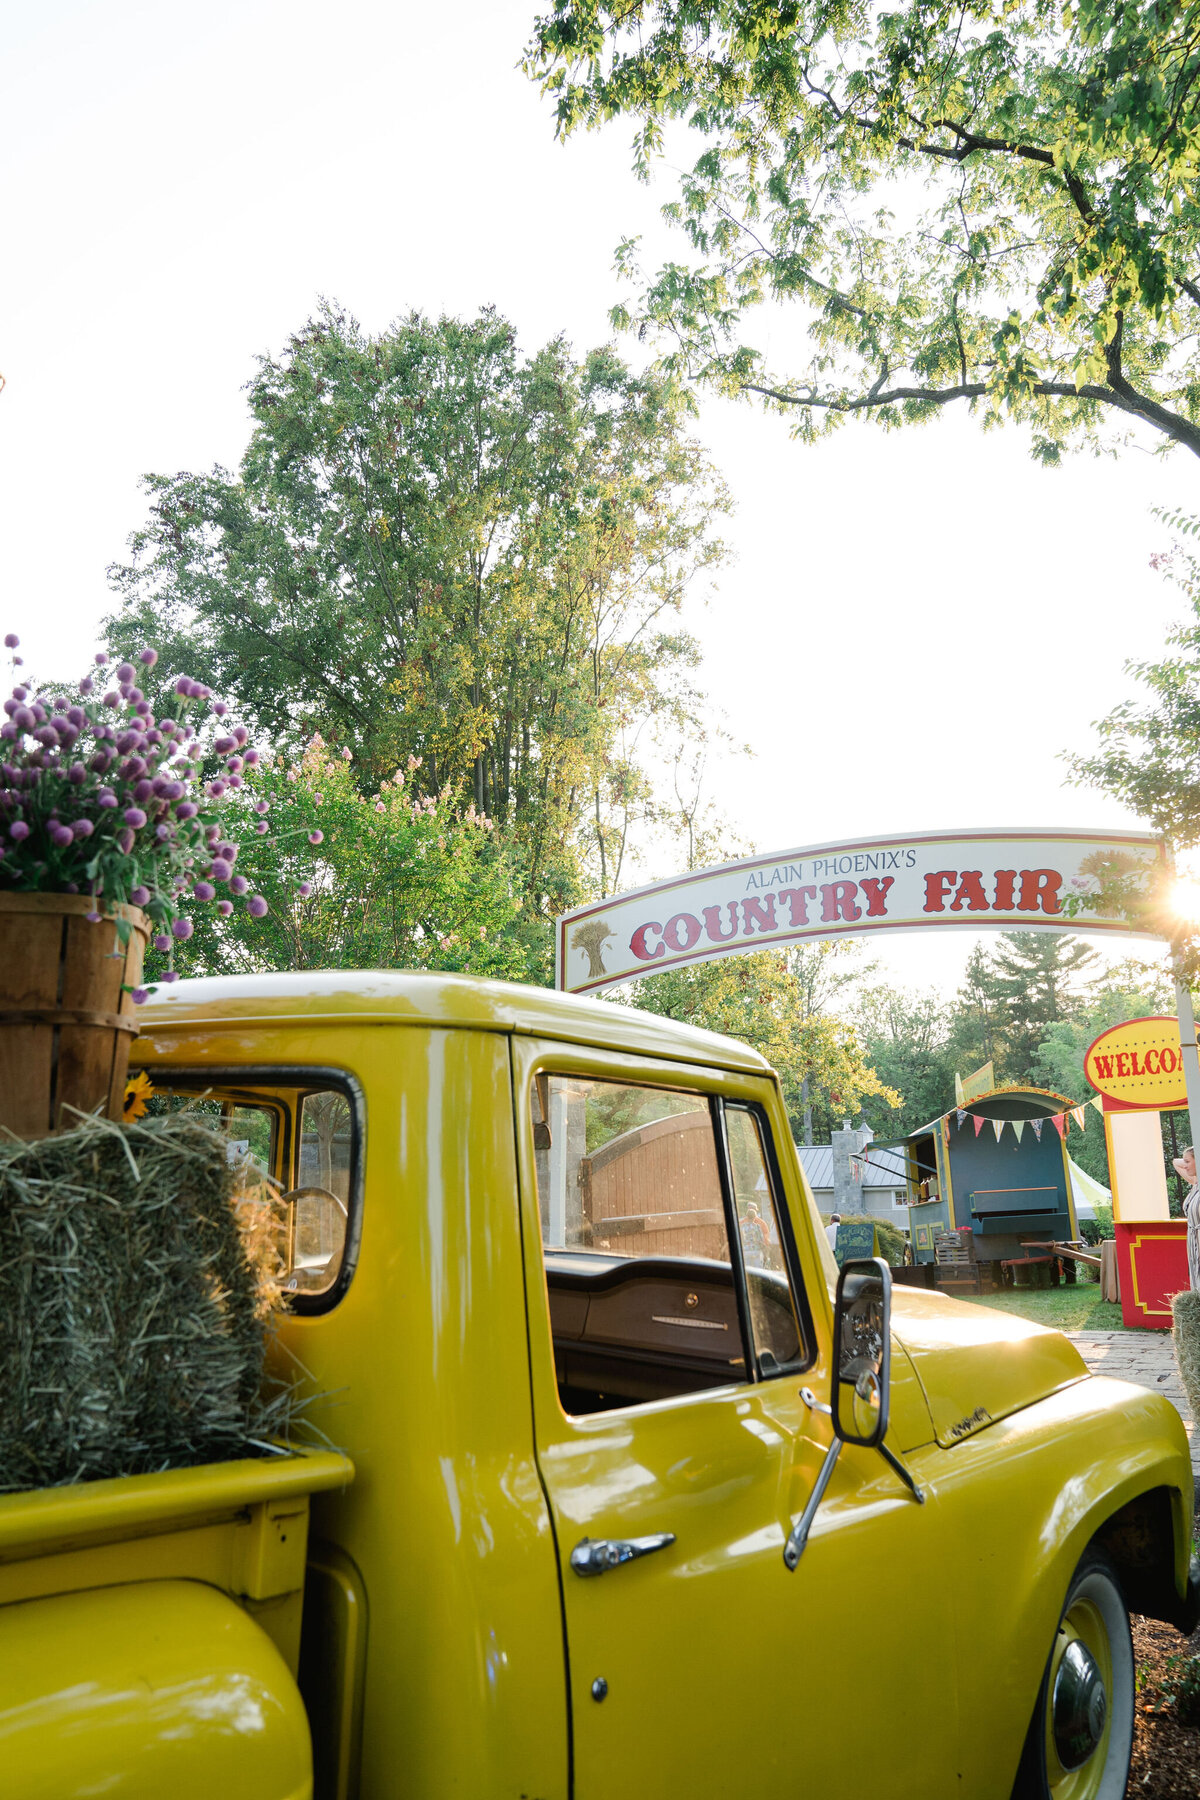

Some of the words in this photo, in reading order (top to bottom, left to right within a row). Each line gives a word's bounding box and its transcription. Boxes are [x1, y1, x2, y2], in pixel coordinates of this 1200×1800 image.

[746, 863, 803, 891] ALAIN
[813, 849, 916, 876] PHOENIX'S
[629, 876, 895, 961] COUNTRY
[923, 869, 1063, 914] FAIR
[1093, 1047, 1183, 1079] WELCO
